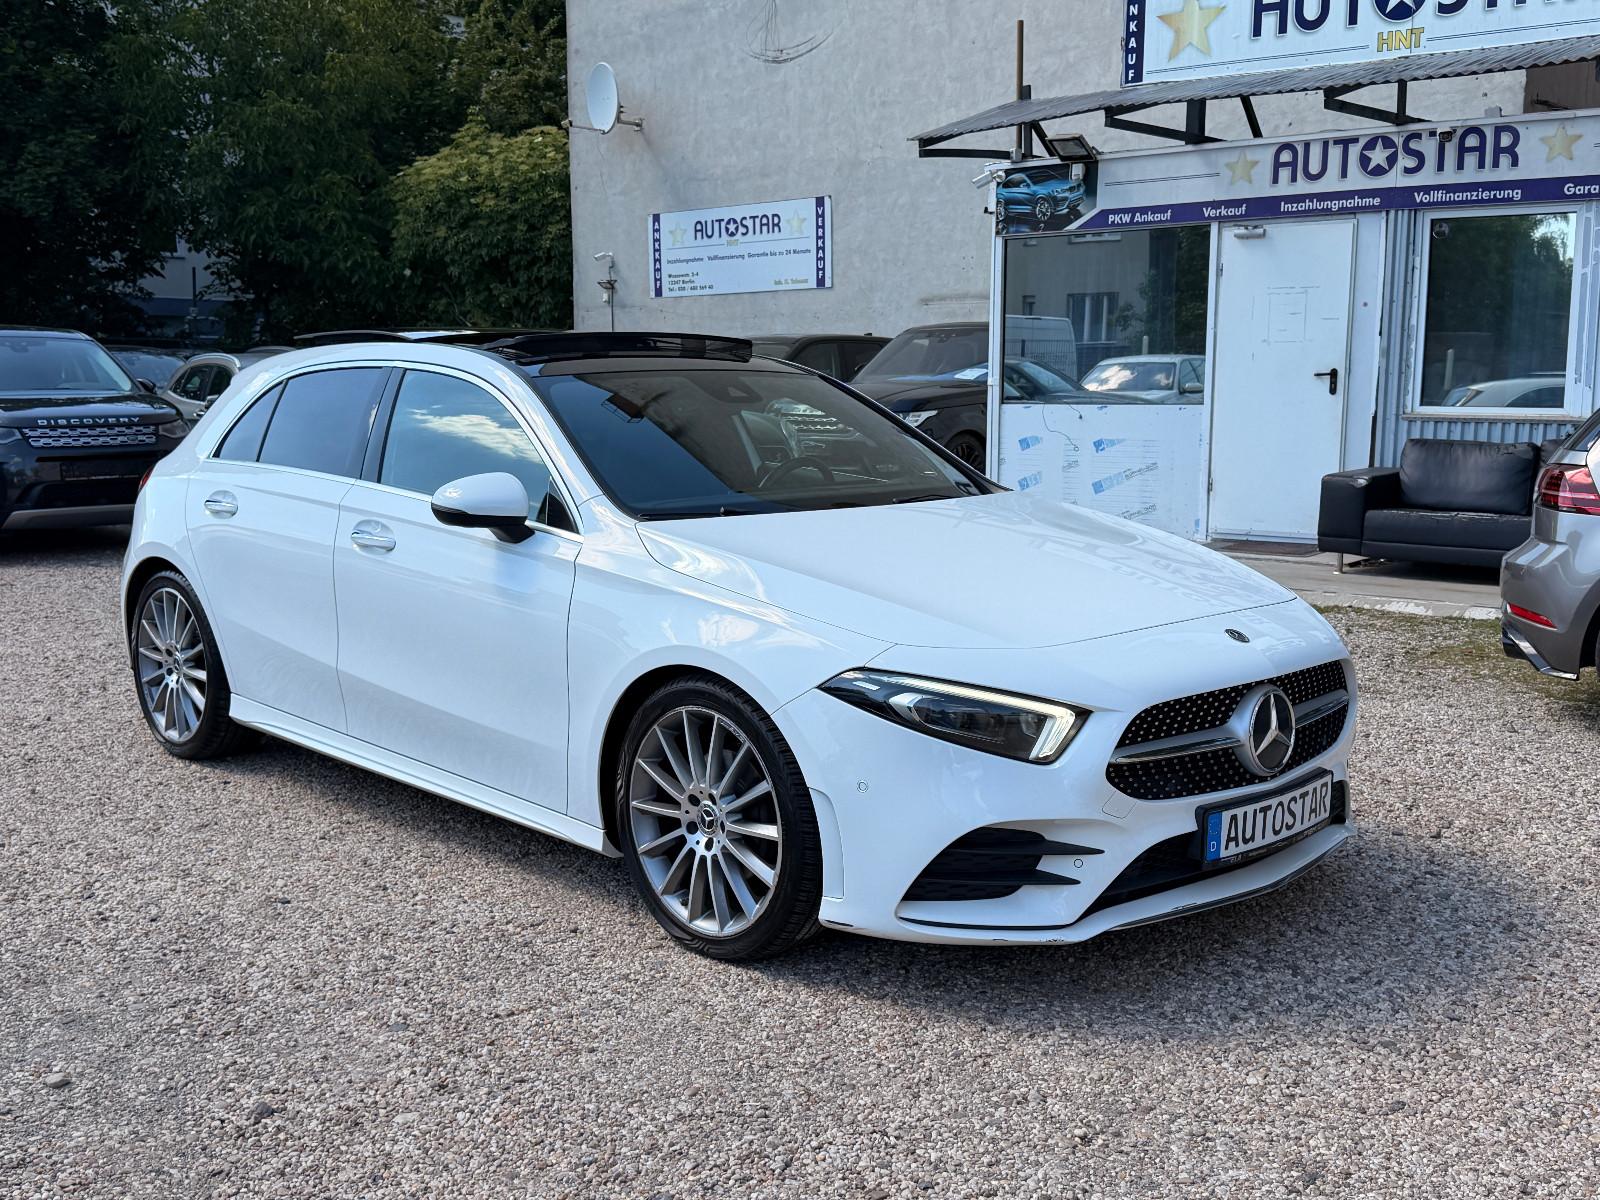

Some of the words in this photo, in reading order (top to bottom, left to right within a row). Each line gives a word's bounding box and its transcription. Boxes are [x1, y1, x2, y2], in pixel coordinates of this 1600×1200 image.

[1377, 27, 1424, 52] HNT
[1271, 124, 1521, 185] AUTOSTAR
[1108, 213, 1131, 224] PKW
[1134, 210, 1171, 223] Ankauf
[1203, 204, 1246, 217] Verkauf
[1280, 195, 1380, 213] Inzahlungnahme
[1414, 188, 1521, 203] Vollfinanzierung
[694, 213, 782, 241] AUTOSTAR
[37, 416, 140, 426] DISCOVERY
[1224, 781, 1329, 851] AUTOSTAR
[1210, 842, 1217, 851] D
